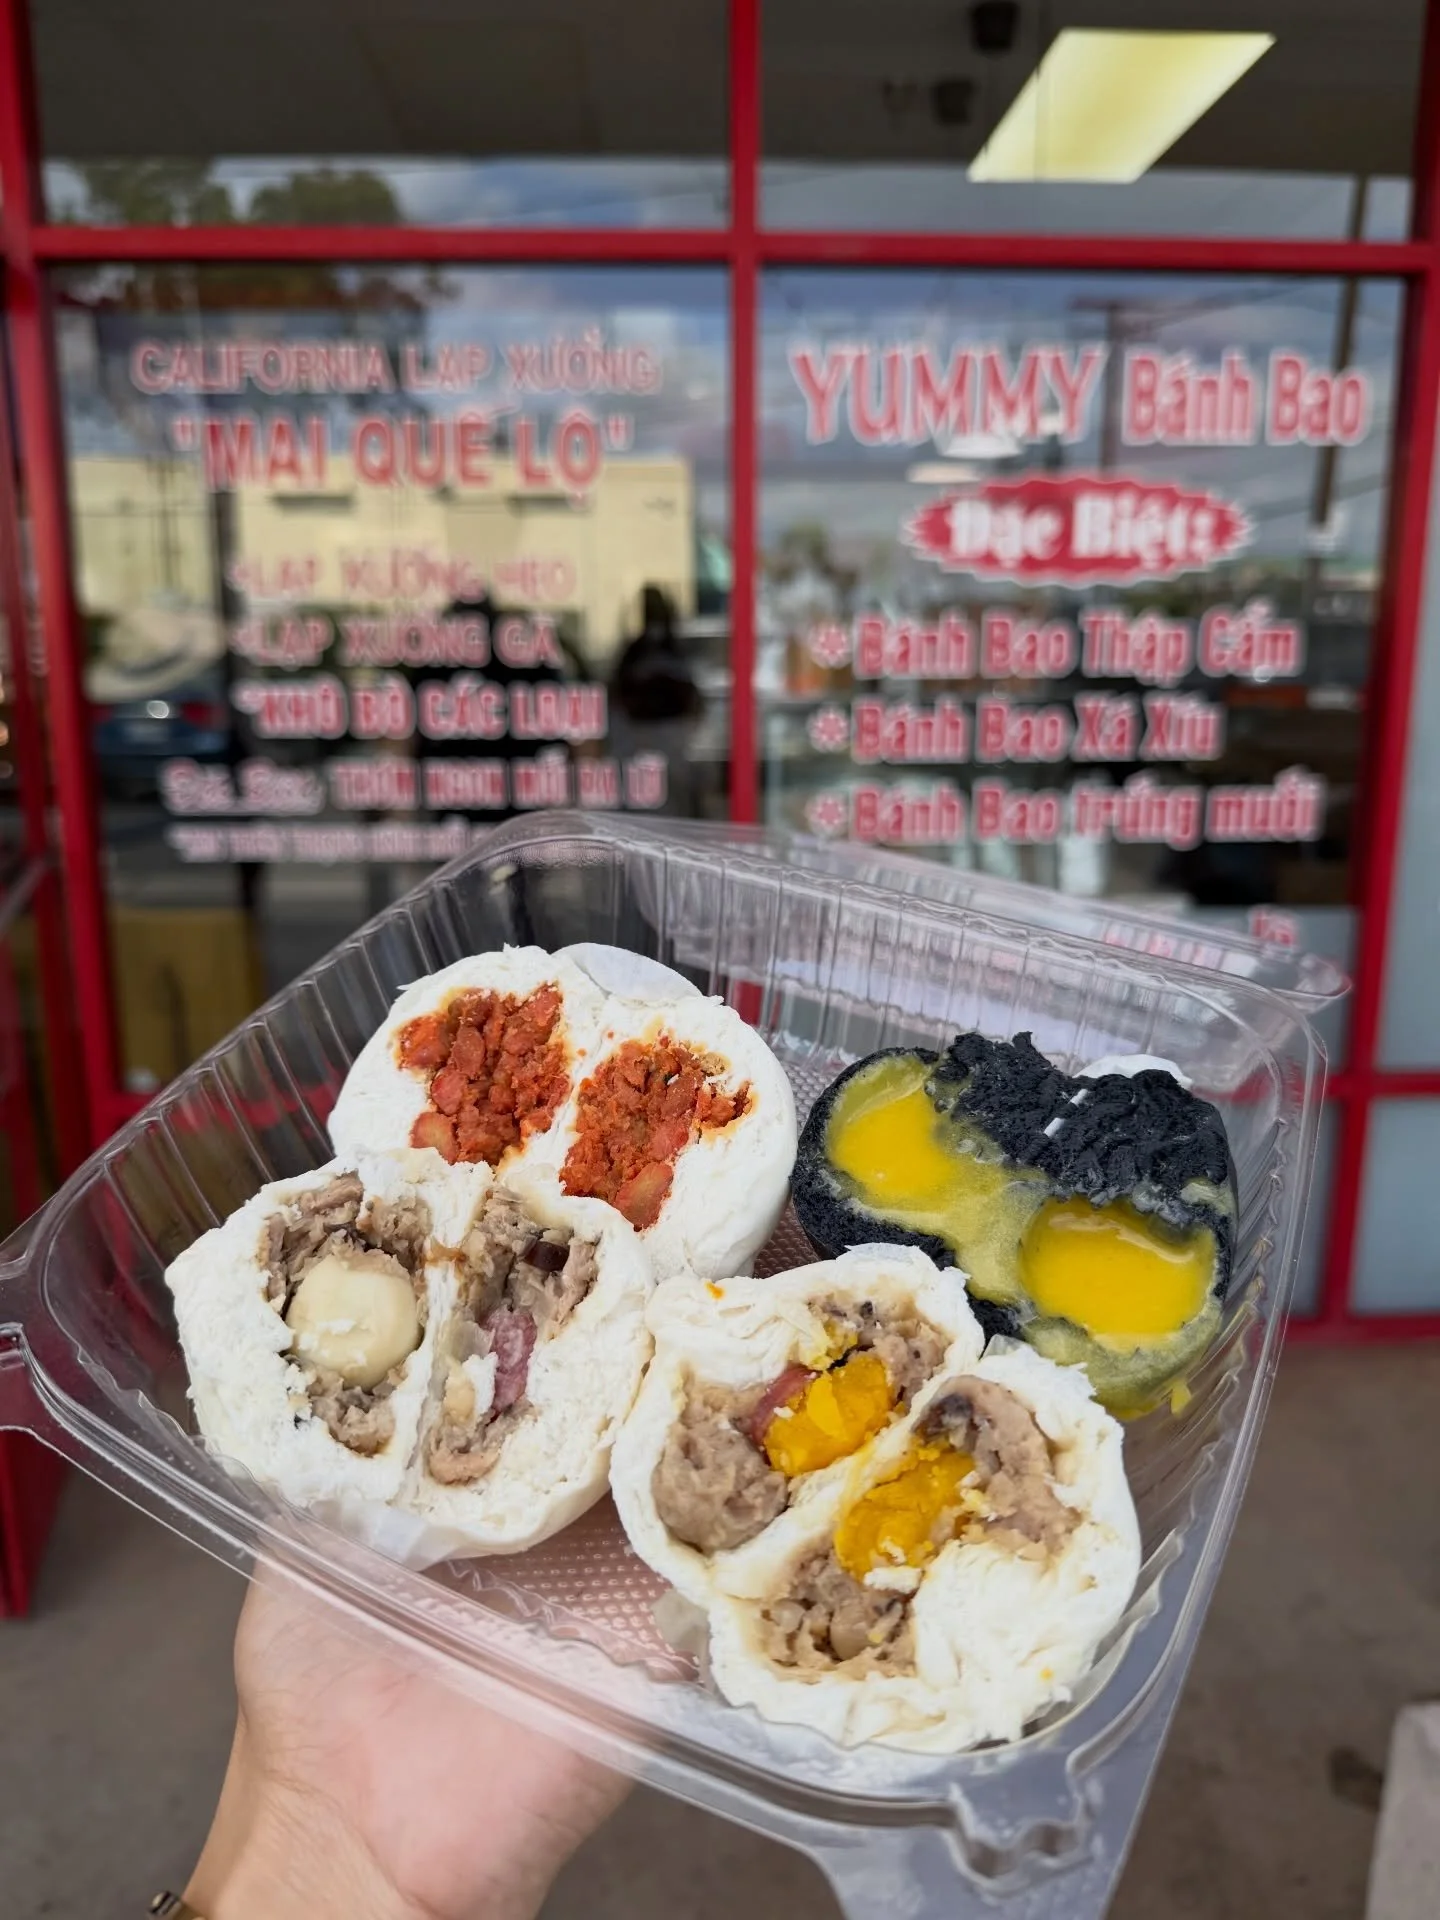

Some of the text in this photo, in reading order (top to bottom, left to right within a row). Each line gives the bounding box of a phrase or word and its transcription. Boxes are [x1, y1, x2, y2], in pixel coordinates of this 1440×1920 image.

[135, 342, 394, 392] CALIFORNIA
[790, 344, 1368, 444] YUMMY Bánh Bao
[174, 414, 331, 488] "MAI
[854, 600, 1304, 687] Bánh Bao Thập Cẩm
[417, 673, 507, 738] CÁC
[853, 693, 1225, 762] Bánh Bao Xá Xíu
[853, 780, 964, 844] Bánh
[973, 780, 1061, 842] Bao
[1205, 766, 1326, 842] muối
